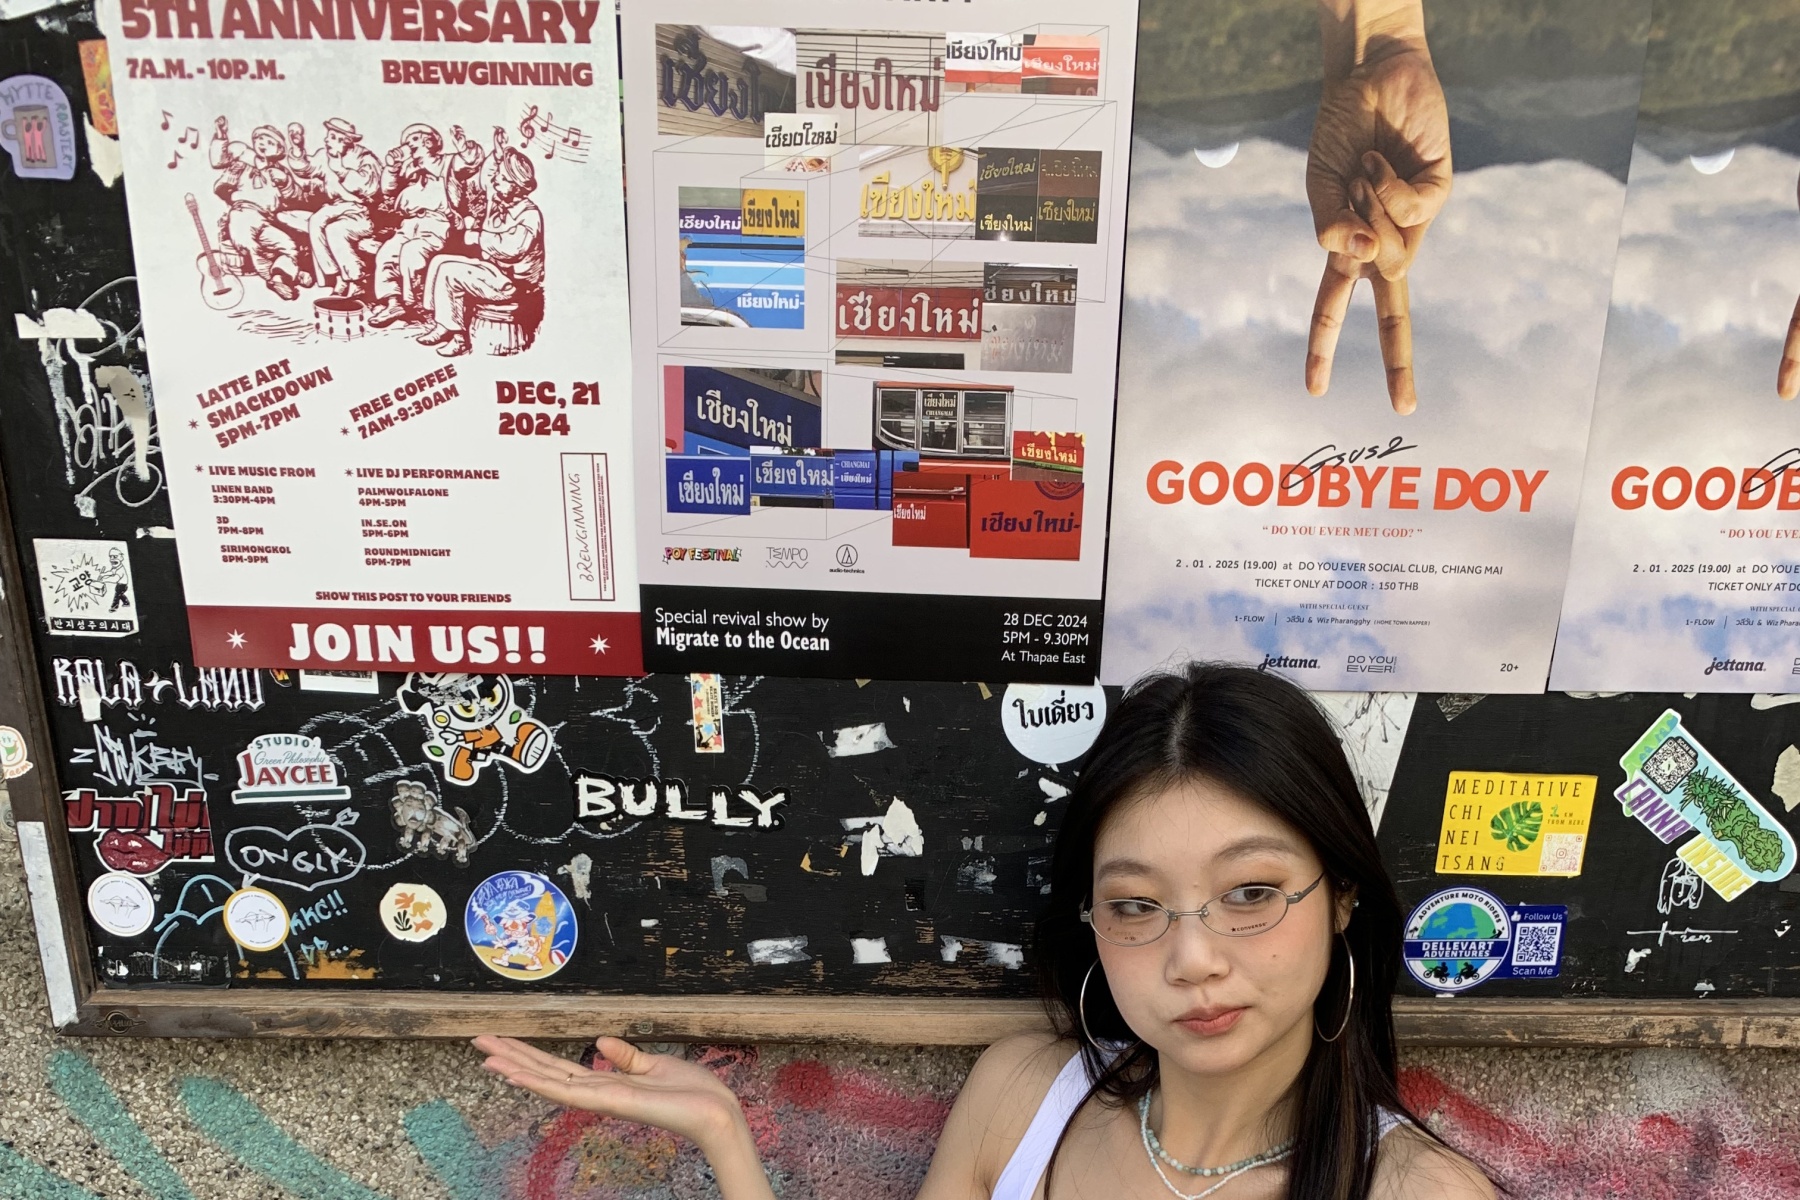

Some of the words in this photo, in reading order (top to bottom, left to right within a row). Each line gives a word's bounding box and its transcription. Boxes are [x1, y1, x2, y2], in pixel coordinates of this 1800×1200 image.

[122, 0, 218, 40] 5TH
[221, 0, 598, 44] ANNIVERSARY
[381, 59, 594, 86] BREWGINNING
[196, 375, 253, 409] LATTE
[254, 358, 292, 386] ART
[206, 366, 334, 429] SMACKDOWN
[349, 393, 394, 422] FREE
[393, 364, 458, 402] COFFEE
[496, 381, 567, 409] DEC,
[571, 381, 600, 405] 21
[357, 383, 460, 440] 7AM-9:30AM
[697, 389, 792, 447] เชียงใหม่
[215, 403, 301, 448] 5PM-7PM
[498, 413, 570, 436] 2024
[208, 465, 236, 476] LIVE
[238, 466, 277, 477] MUSIC
[280, 467, 316, 478] FROM
[356, 468, 383, 478] LIVE
[386, 468, 400, 478] DJ
[402, 469, 499, 480] PERFORMANCE
[755, 460, 834, 486] เชียงใหม่
[211, 485, 242, 494] LINEN
[244, 486, 273, 494] BAND
[358, 487, 449, 496] PALMWOLFALONE
[1146, 460, 1422, 510] GOODBYE
[1433, 468, 1550, 513] DOY
[213, 495, 276, 505] 3:30PM-4PM
[359, 498, 406, 507] 4PM-5PM
[216, 516, 230, 524] 3D
[568, 473, 594, 582] BREWGINNING
[217, 526, 264, 535] 7PM-8PM
[362, 529, 409, 538] 5PM-6PM
[1271, 525, 1289, 535] DO
[1291, 526, 1316, 536] YOU
[1319, 526, 1350, 536] EVER
[1353, 527, 1379, 537] MET
[1382, 528, 1414, 538] GOD?
[1728, 529, 1745, 538] DO
[1748, 529, 1773, 538] YOU
[220, 545, 292, 554] SIRIMONGKOL
[364, 548, 451, 557] ROUNDMIDNIGHT
[688, 547, 739, 562] FESTIVAL
[222, 555, 269, 563] 8PM-9PM
[365, 558, 411, 566] 6PM-7PM
[1215, 560, 1239, 568] 2025
[1243, 560, 1277, 570] (19.00)
[1282, 562, 1292, 570] at
[1298, 561, 1315, 571] DO
[1317, 562, 1340, 571] YOU
[1340, 562, 1366, 572] EVER
[1368, 563, 1406, 573] SOCIAL
[1408, 563, 1437, 574] CLUB,
[1441, 564, 1482, 574] CHIANG
[1484, 565, 1503, 575] MAI
[1671, 564, 1694, 573] 2025
[1698, 564, 1731, 574] (19.00)
[1736, 565, 1746, 573] at
[1752, 564, 1768, 573] DO
[1770, 565, 1792, 573] YOU
[1255, 578, 1292, 588] TICKET
[1293, 579, 1321, 589] ONLY
[1322, 580, 1336, 589] AT
[1337, 580, 1368, 589] DOOR
[1379, 581, 1396, 590] 150
[1398, 582, 1419, 591] THB
[1708, 582, 1743, 591] TICKET
[1745, 582, 1772, 591] ONLY
[1774, 582, 1788, 591] AT
[315, 591, 351, 601] SHOW
[352, 592, 377, 601] THIS
[379, 592, 408, 602] POST
[410, 593, 425, 602] TO
[426, 593, 459, 602] YOUR
[461, 593, 512, 603] FRIENDS
[655, 607, 707, 626] Special
[713, 611, 760, 626] revival
[766, 614, 807, 628] show
[812, 613, 829, 633] by
[1003, 613, 1020, 626] 28
[1023, 614, 1053, 627] DEC
[1057, 614, 1088, 628] 2024
[289, 623, 414, 662] JOIN
[428, 627, 547, 665] US!!
[656, 627, 720, 653] Migrate
[724, 630, 743, 648] to
[747, 630, 776, 650] the
[780, 632, 830, 651] Ocean
[1002, 631, 1031, 644] 5PM
[1043, 632, 1089, 646] 9.30PM
[1001, 649, 1016, 662] At
[1019, 650, 1059, 665] Thapae
[1060, 651, 1086, 664] East
[1258, 653, 1318, 671] jettana
[1347, 655, 1366, 664] DO
[1368, 655, 1394, 664] YOU
[1500, 663, 1519, 672] 20+
[1704, 657, 1764, 676] jettana
[256, 736, 310, 749] STUDIO
[254, 751, 282, 765] Green
[242, 753, 333, 786] JAYCEE
[1453, 779, 1582, 797] MEDITATIVE
[576, 774, 786, 828] BULLY
[1450, 805, 1482, 820] CHI
[1445, 830, 1479, 845] NEI
[1442, 855, 1505, 871] TSANG
[1679, 835, 1754, 898] INSIDE
[1418, 893, 1459, 920] ADVENTURE
[1461, 892, 1484, 903] MOTO
[1484, 901, 1502, 924] RIDERS
[1524, 912, 1551, 920] Follow
[1422, 941, 1494, 951] DELLEVART
[1512, 967, 1536, 975] Scan
[1537, 967, 1553, 975] Me
